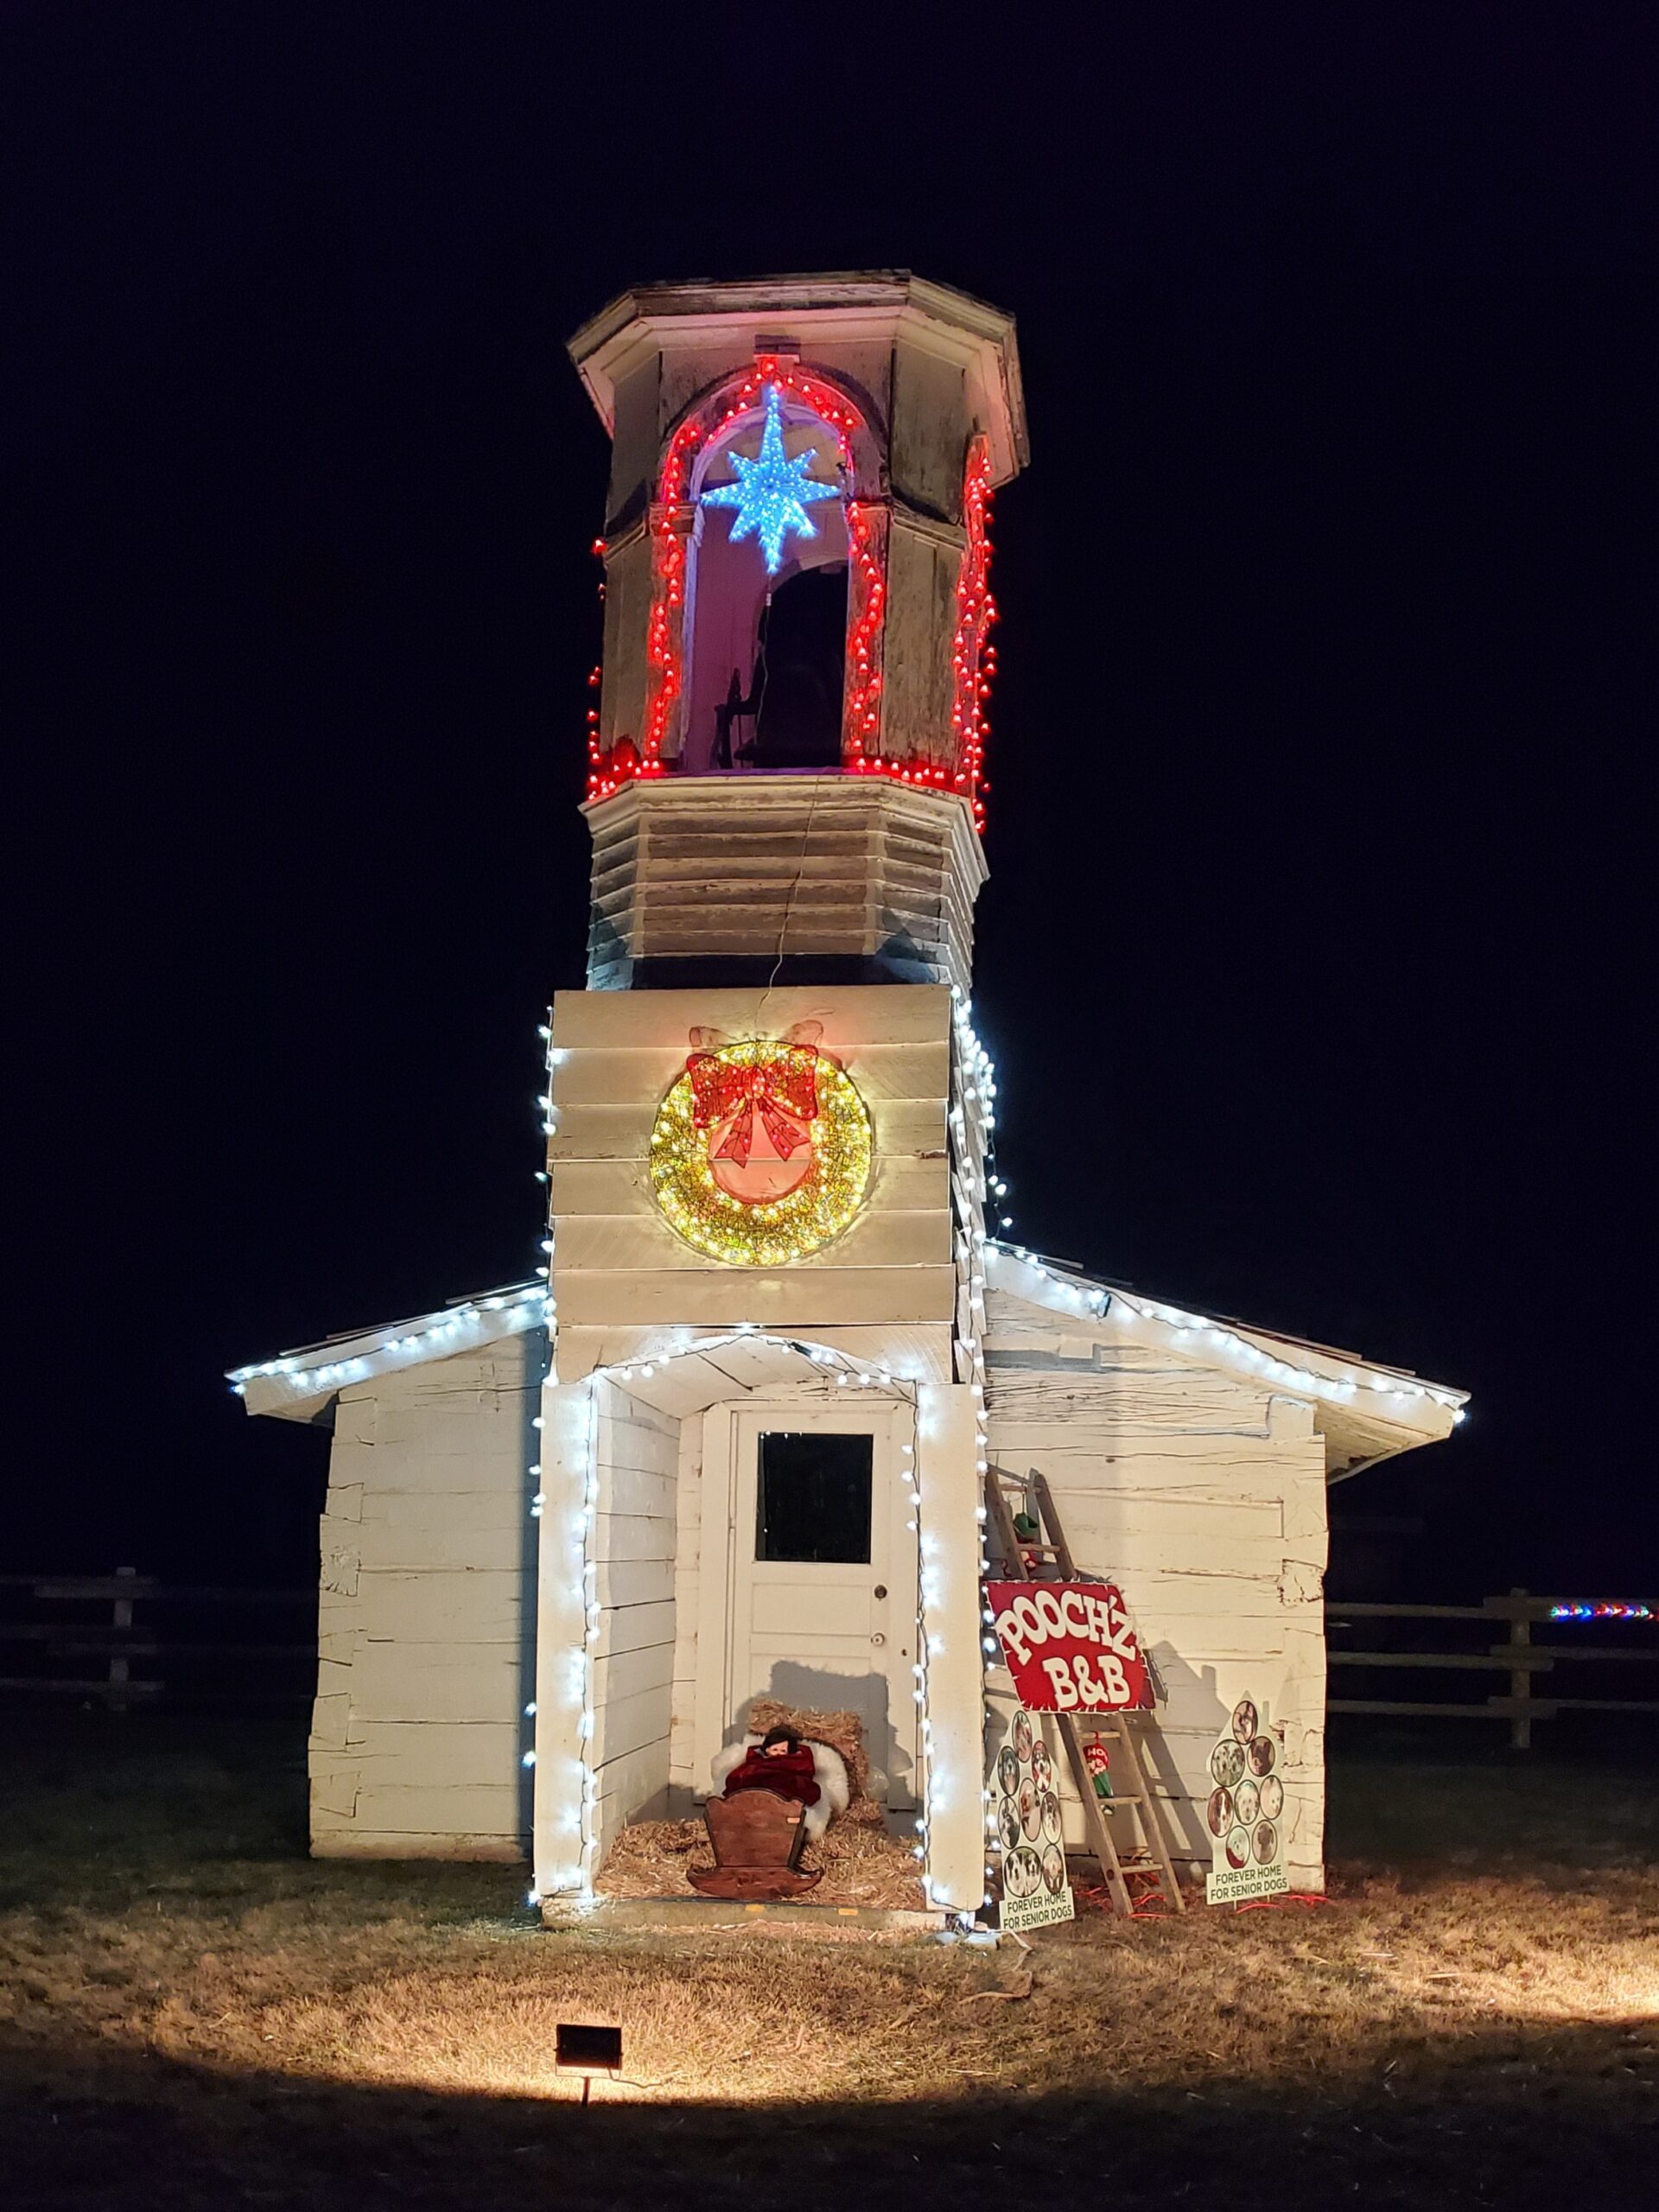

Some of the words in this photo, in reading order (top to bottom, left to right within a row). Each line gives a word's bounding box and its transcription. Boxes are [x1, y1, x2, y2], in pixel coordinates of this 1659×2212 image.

[994, 1590, 1136, 1666] POOCH'Z
[1041, 1655, 1130, 1708] B&B
[1216, 1869, 1255, 1885] FOREVER
[1257, 1865, 1281, 1878] HOME
[1211, 1887, 1229, 1901] FOR
[1230, 1882, 1262, 1897] SENIOR
[1263, 1878, 1287, 1891] DOGS
[1007, 1896, 1043, 1914] FOREVER
[1044, 1891, 1066, 1905] HOME
[1003, 1916, 1020, 1929] FOR
[1021, 1910, 1050, 1926] SENIOR
[1051, 1904, 1071, 1919] DOGS
